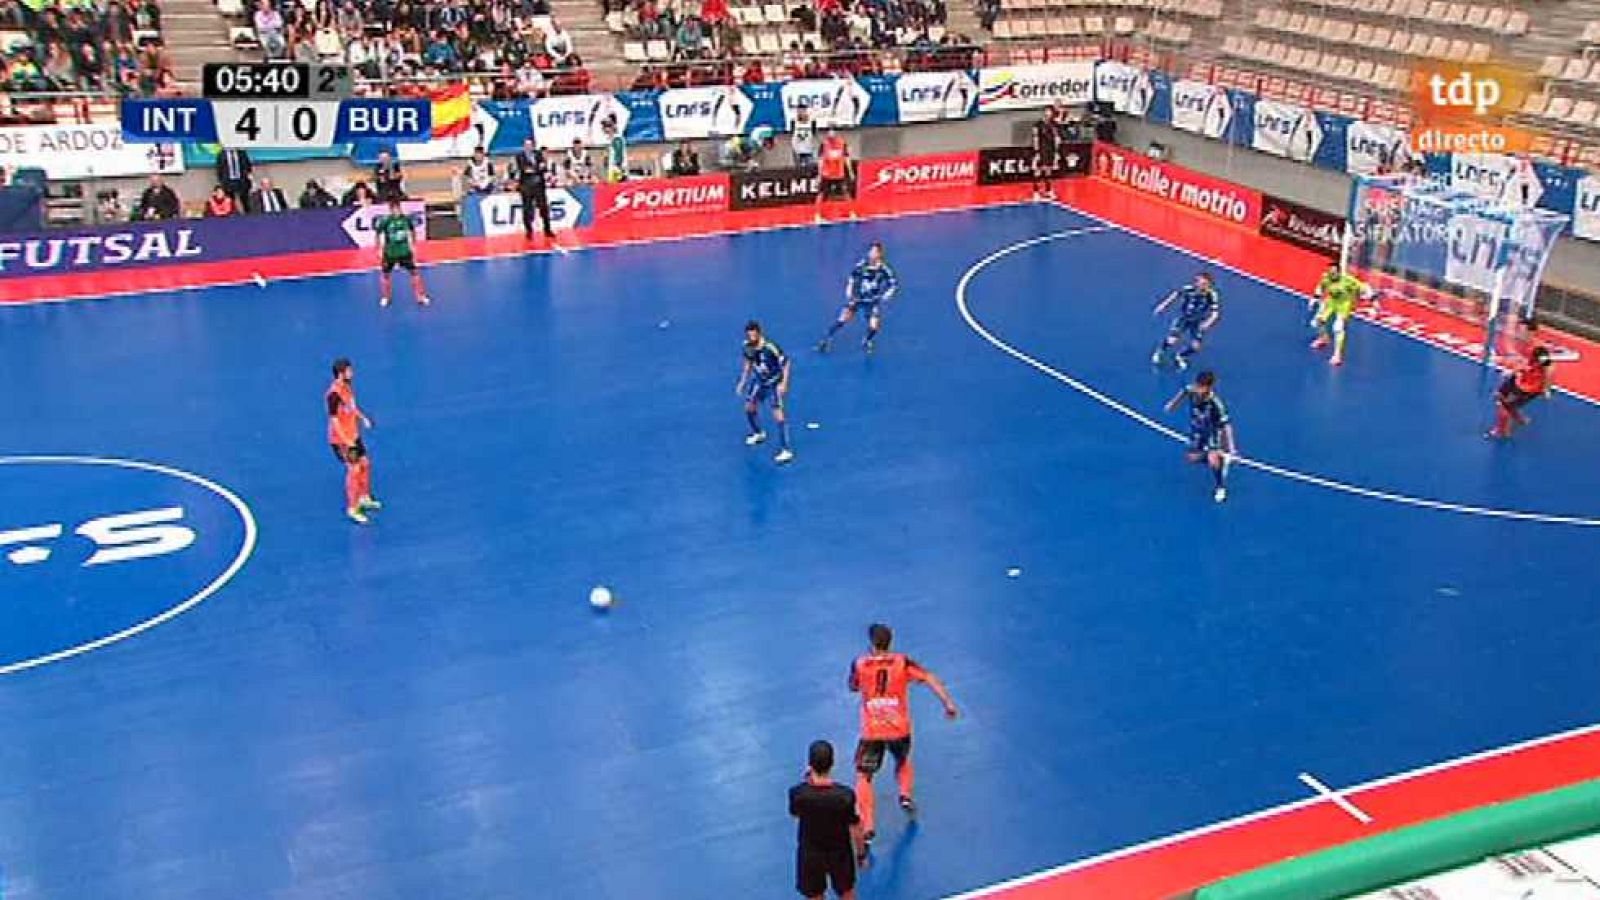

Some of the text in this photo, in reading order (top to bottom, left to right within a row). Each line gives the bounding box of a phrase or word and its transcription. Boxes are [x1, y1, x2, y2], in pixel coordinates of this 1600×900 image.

[1010, 79, 1090, 98] Corredor
[0, 129, 123, 153] DE ARDOZ
[877, 160, 974, 185] SPORTIUM
[613, 184, 725, 210] SPORTIUM
[741, 178, 819, 199] KELME
[1111, 153, 1129, 181] Tu
[1182, 183, 1246, 222] motrio
[0, 229, 203, 270] FUTSAL
